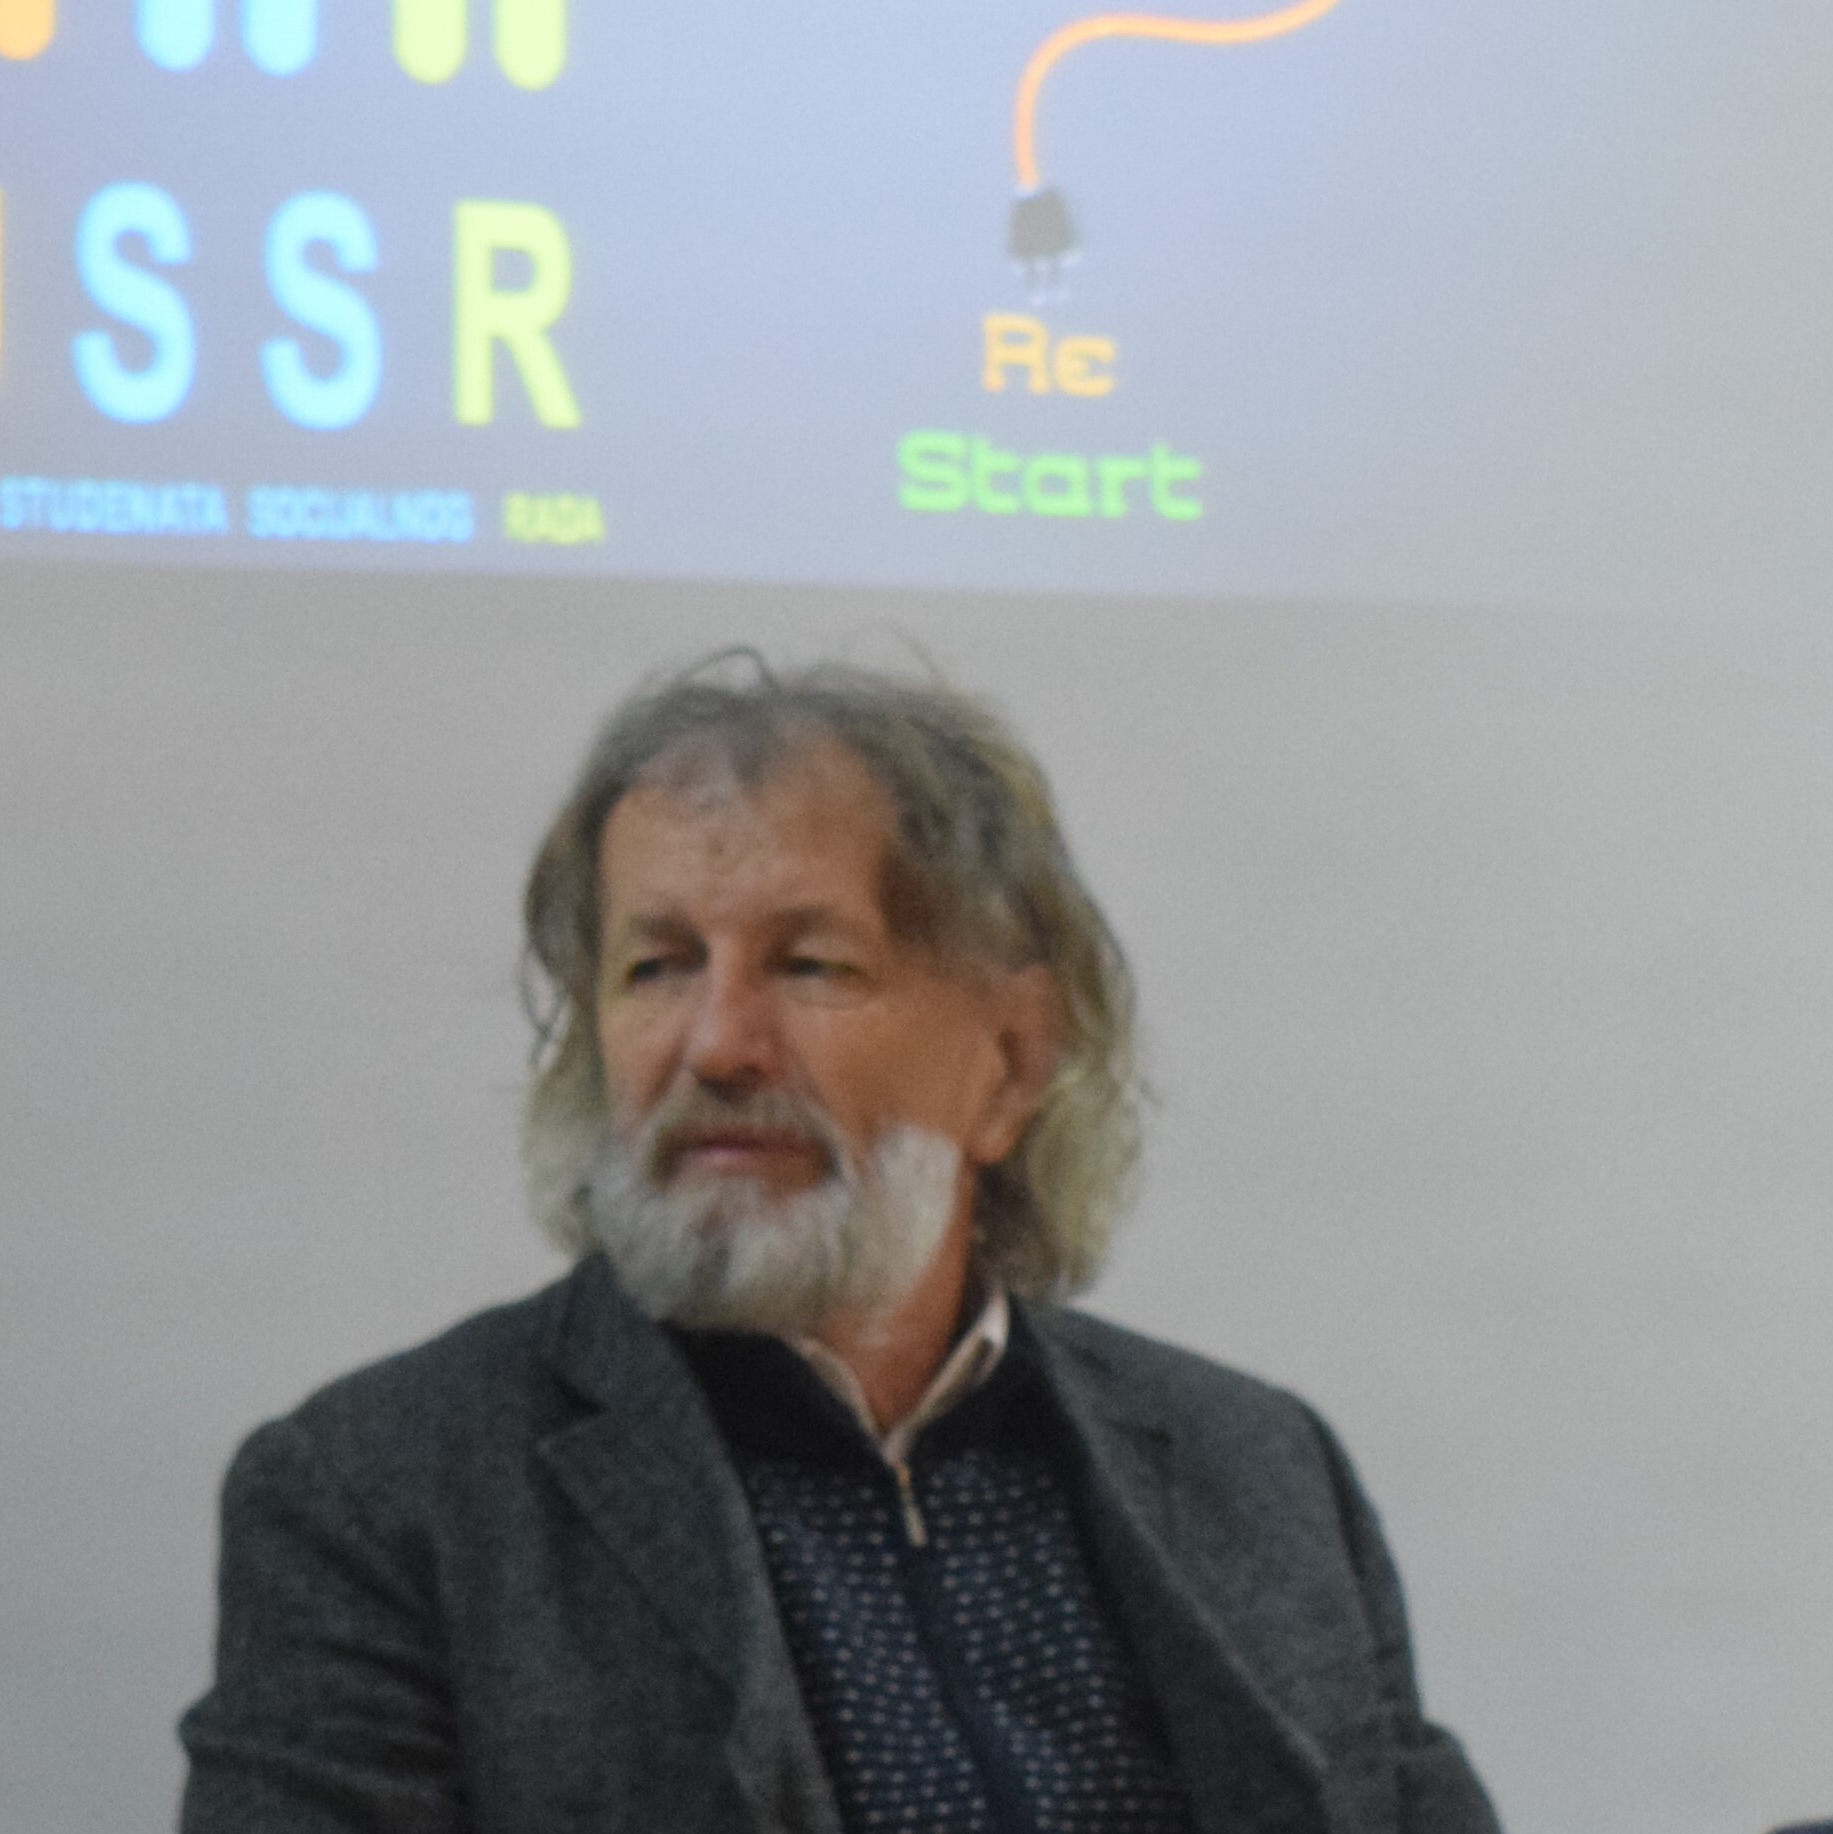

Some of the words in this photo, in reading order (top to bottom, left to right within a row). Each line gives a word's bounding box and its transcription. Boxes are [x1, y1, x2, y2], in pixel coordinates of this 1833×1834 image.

[981, 312, 1118, 397] Re
[503, 489, 605, 544] RADA
[896, 427, 1203, 521] Start
